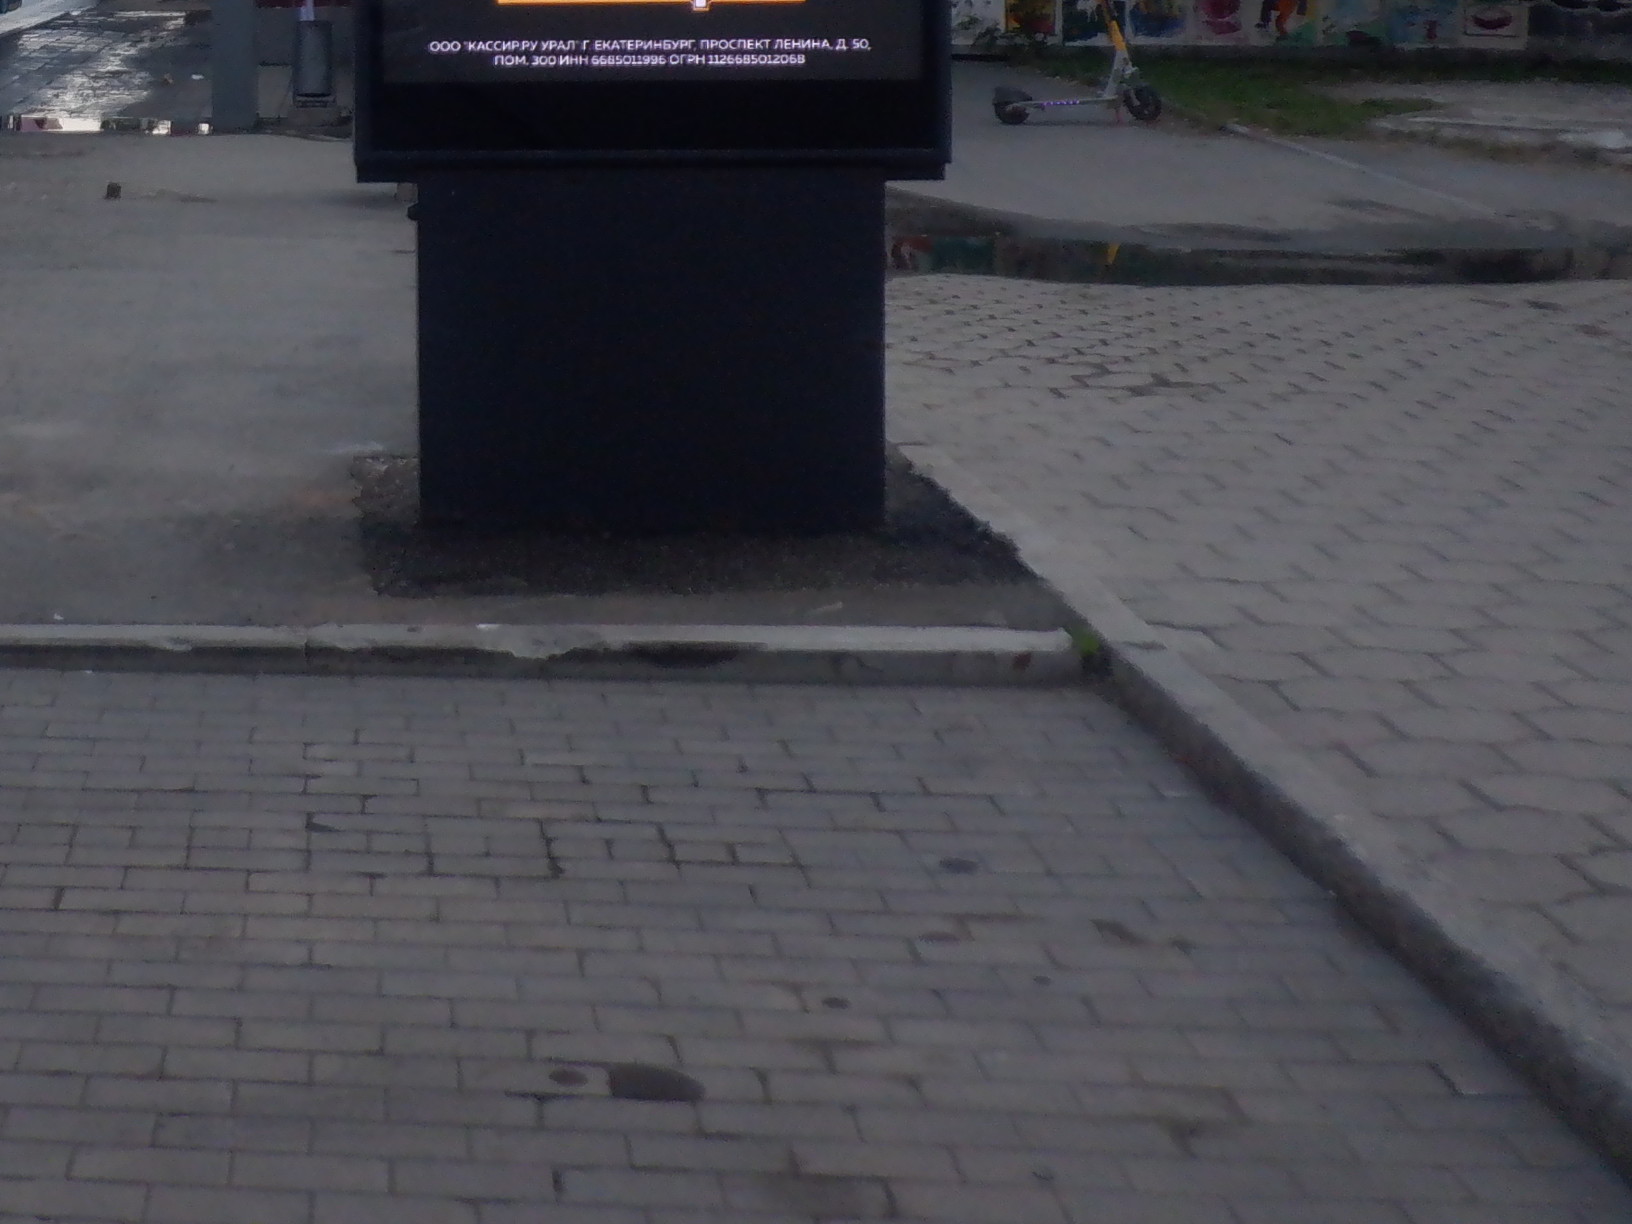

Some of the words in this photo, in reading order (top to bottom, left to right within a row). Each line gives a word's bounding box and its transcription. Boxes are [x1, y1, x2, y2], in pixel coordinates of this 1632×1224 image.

[429, 41, 461, 52] ООО
[700, 39, 771, 50] ПРОСПЕКТ
[531, 55, 556, 65] 300
[559, 54, 589, 65] ИНН
[669, 53, 706, 64] ОГРН
